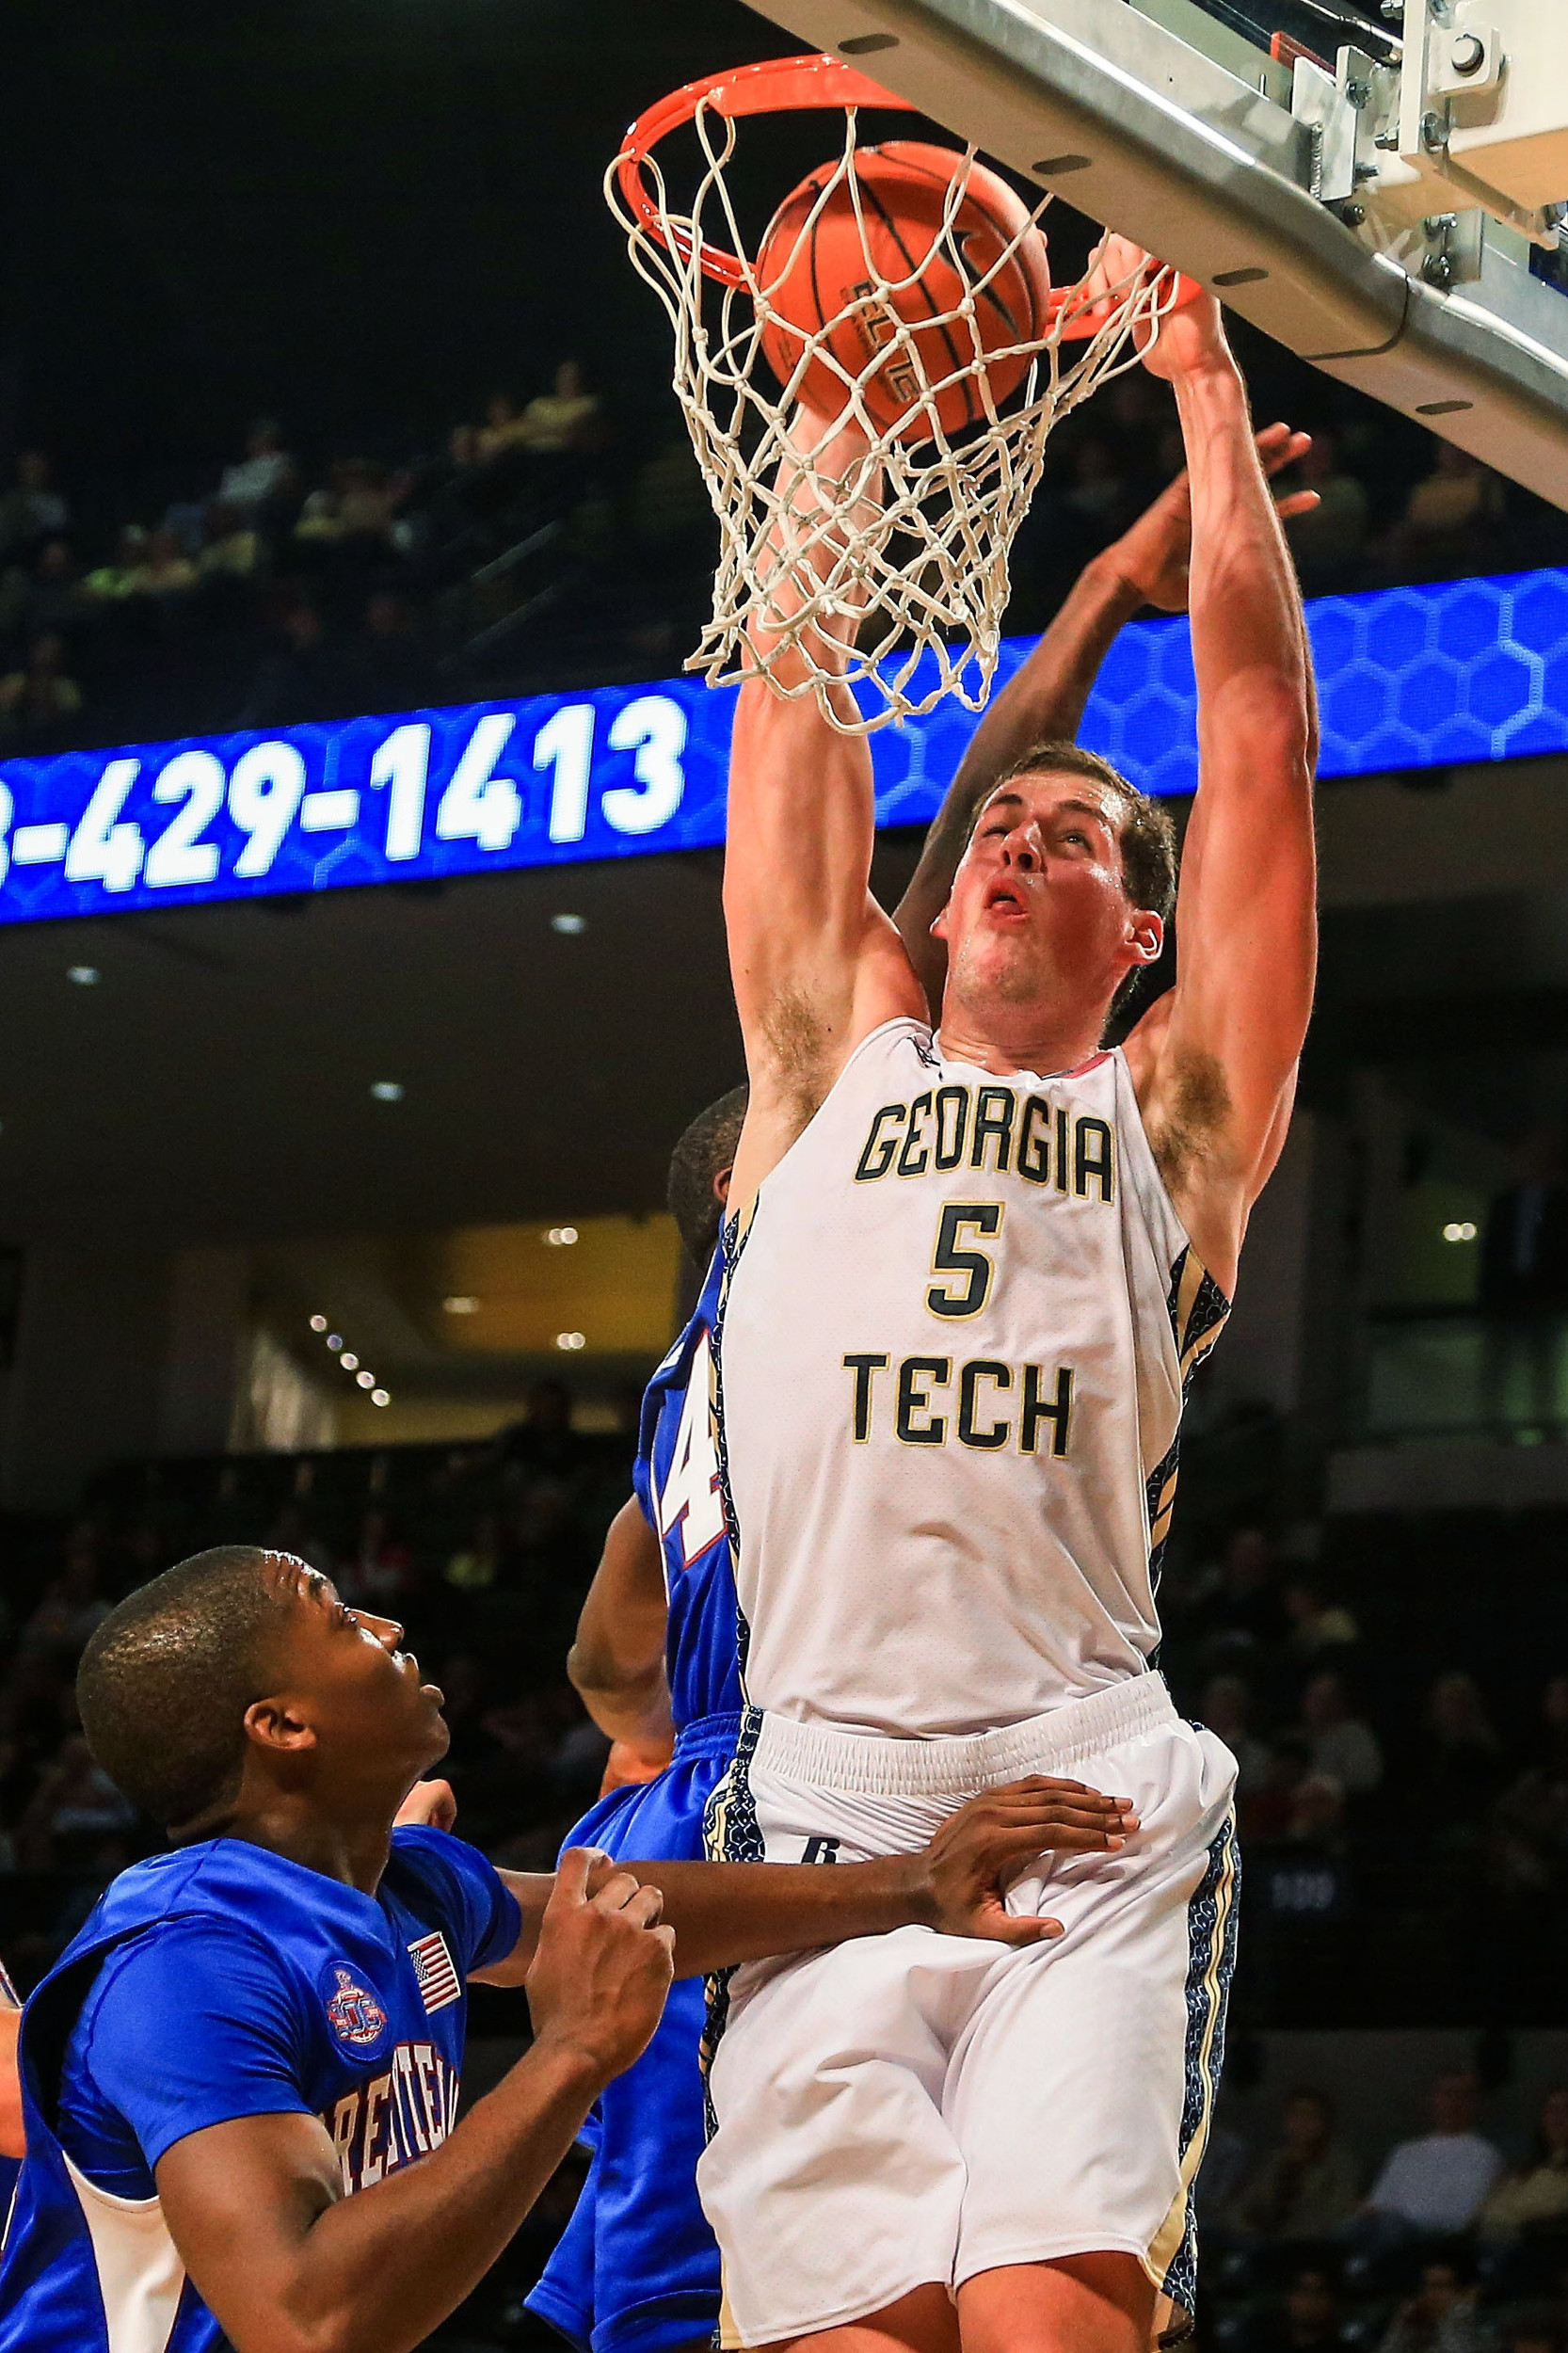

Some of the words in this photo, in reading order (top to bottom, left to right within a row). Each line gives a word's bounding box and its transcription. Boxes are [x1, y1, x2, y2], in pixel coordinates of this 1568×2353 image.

[0, 696, 688, 891] -429-1413
[854, 1084, 1115, 1206] GEORGIA
[924, 1200, 1005, 1321] 5
[840, 1352, 1074, 1460] TECH
